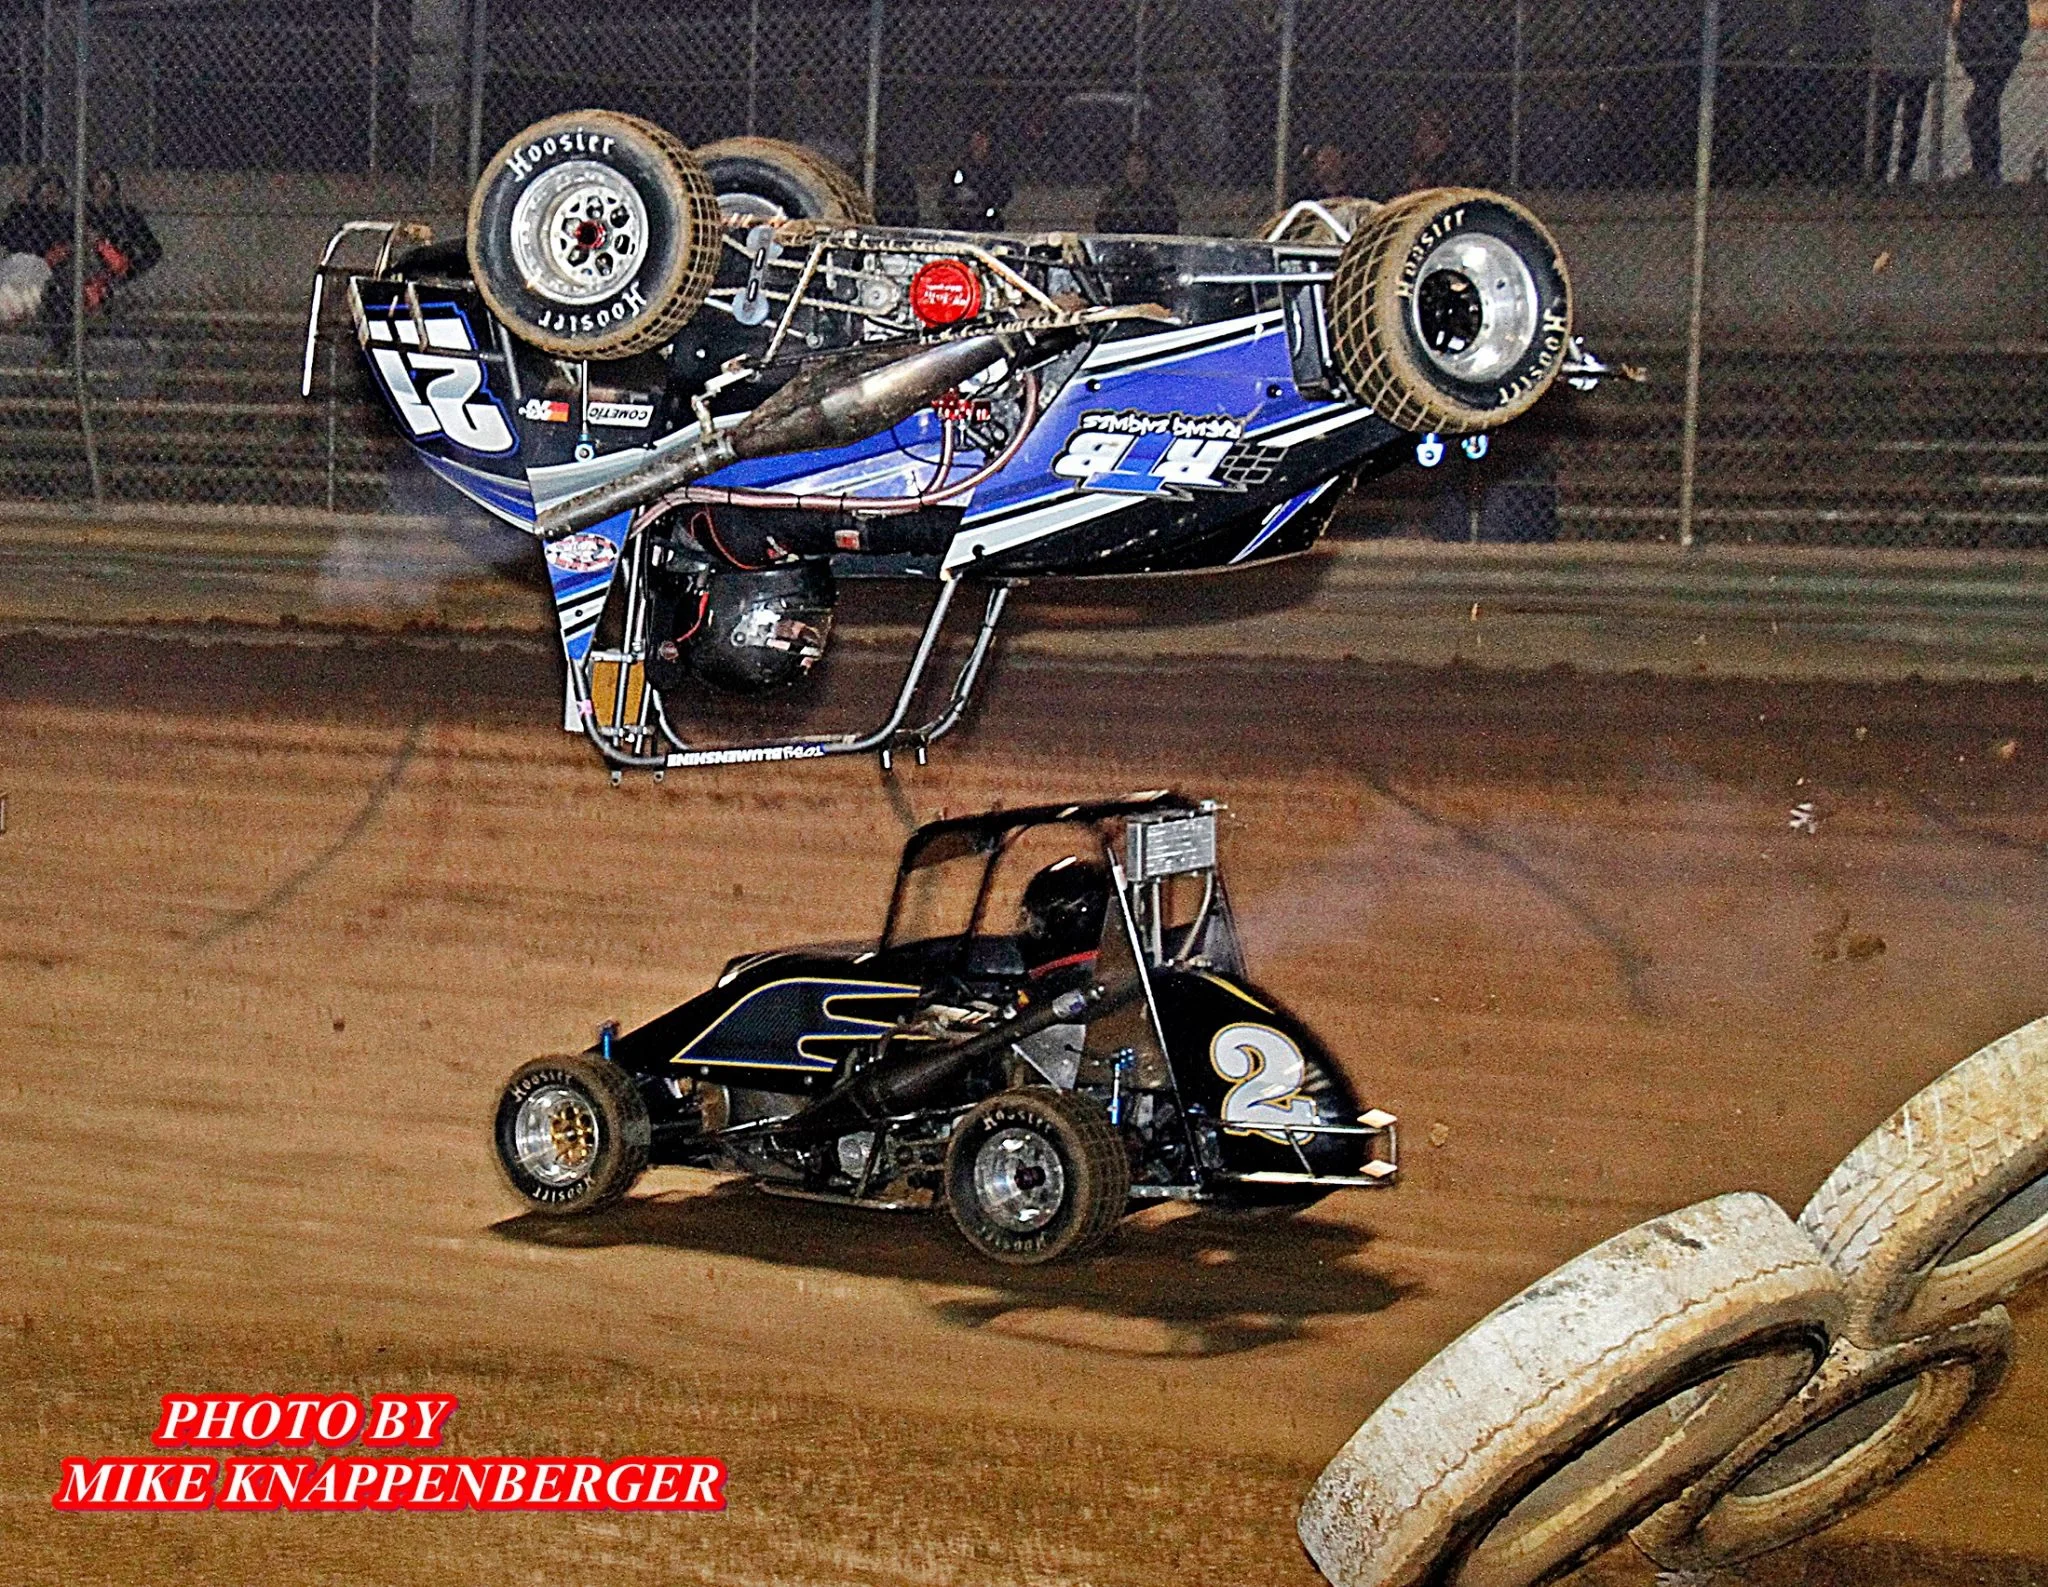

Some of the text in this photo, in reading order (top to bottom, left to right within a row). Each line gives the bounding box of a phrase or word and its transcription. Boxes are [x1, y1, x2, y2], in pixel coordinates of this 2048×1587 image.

[505, 127, 616, 182] Hoosier
[538, 281, 647, 336] Hoosier
[365, 314, 516, 454] 21
[589, 407, 648, 421] COMETIC
[1054, 431, 1233, 492] RTB
[1209, 1022, 1316, 1145] 2
